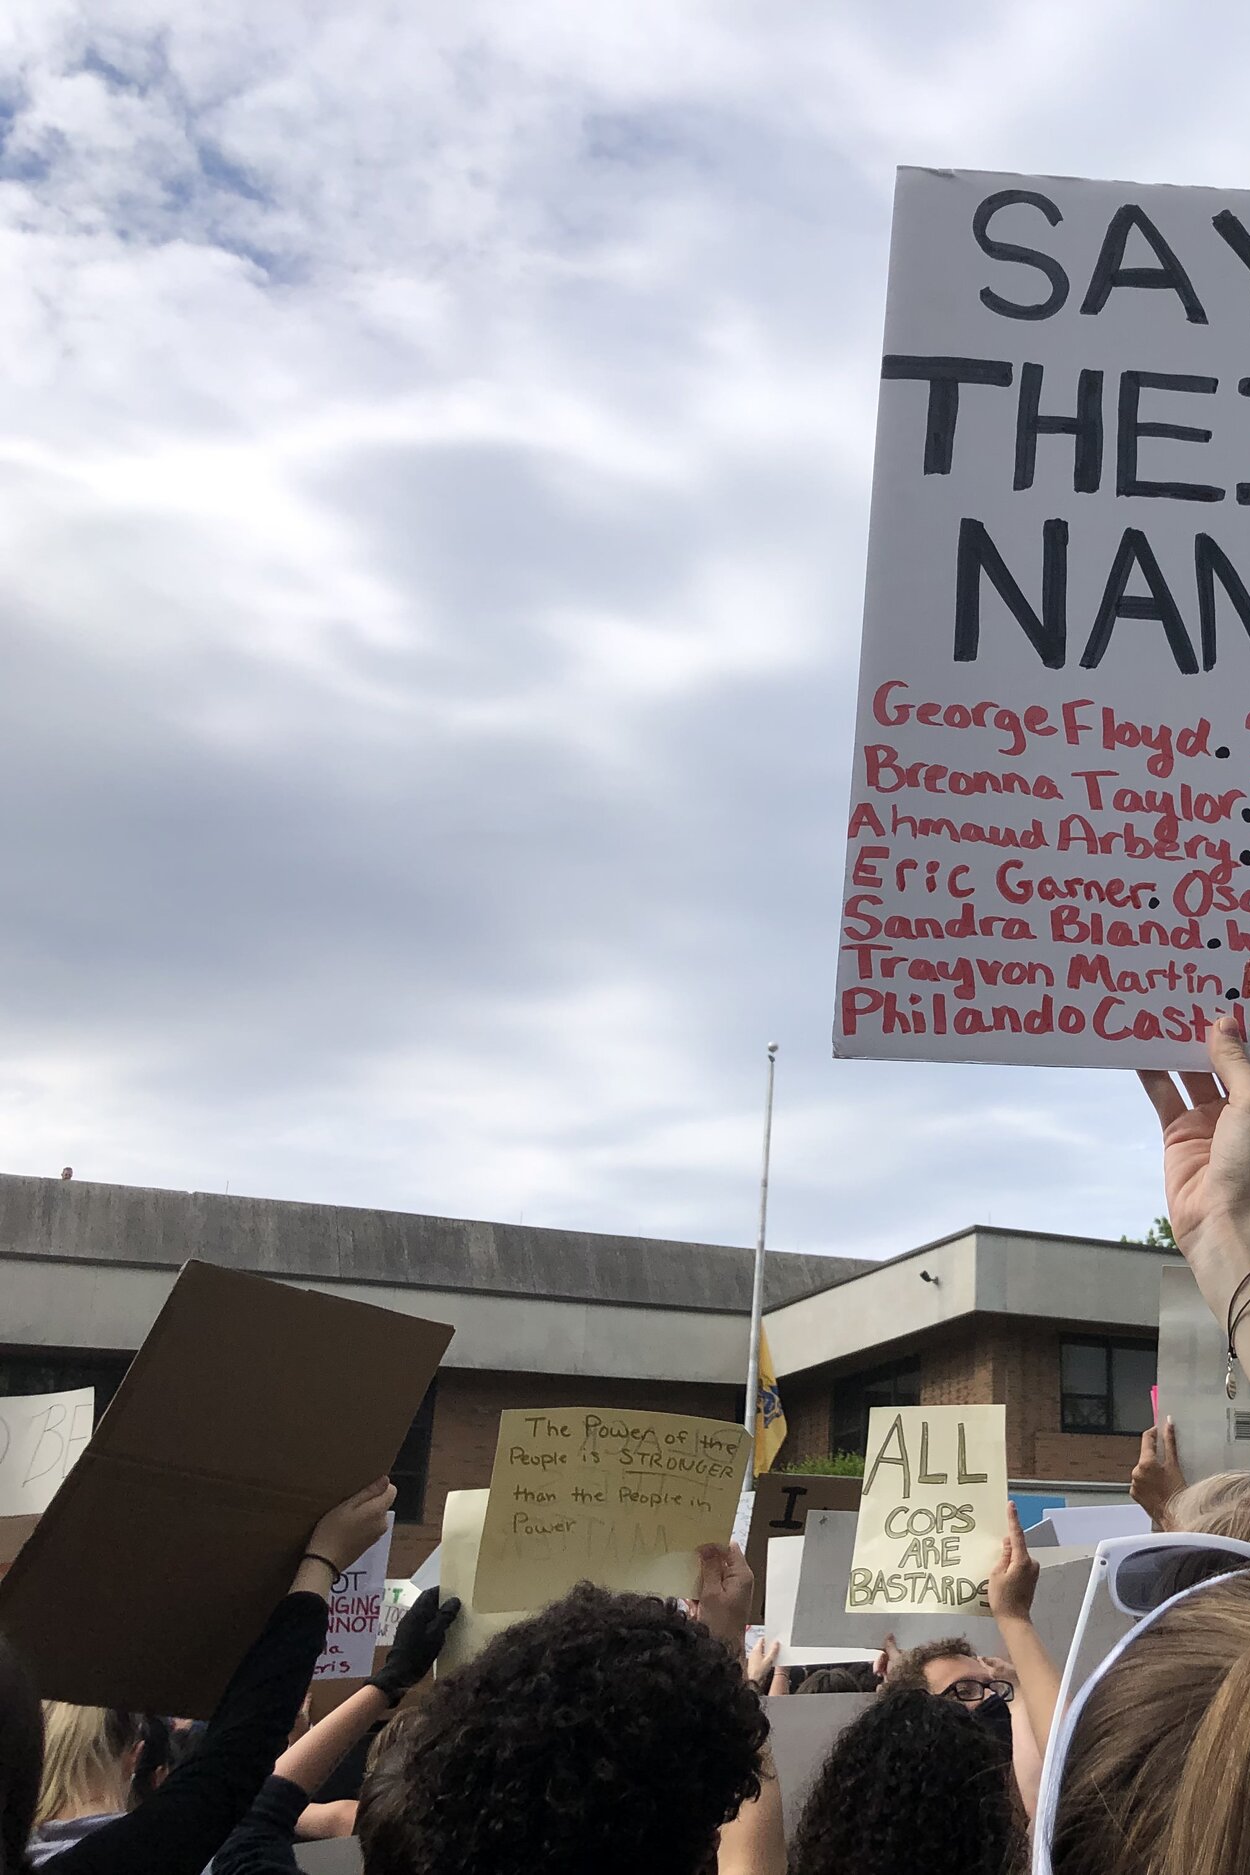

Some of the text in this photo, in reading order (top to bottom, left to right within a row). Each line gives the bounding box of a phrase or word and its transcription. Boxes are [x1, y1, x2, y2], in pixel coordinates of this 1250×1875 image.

[872, 680, 1059, 756] George
[848, 803, 1051, 850] Ahmaud
[852, 846, 976, 898] Eric
[843, 894, 1038, 941] Sandra
[841, 944, 1055, 1000] Trayvon
[842, 986, 1087, 1036] Philando
[510, 1446, 567, 1470] People
[582, 1450, 600, 1464] is
[525, 1414, 739, 1456] The Power of the
[862, 1413, 988, 1498] ALL
[513, 1484, 711, 1512] than the People in
[885, 1502, 976, 1539] COPS
[512, 1511, 576, 1535] Power
[898, 1536, 961, 1569] ARE
